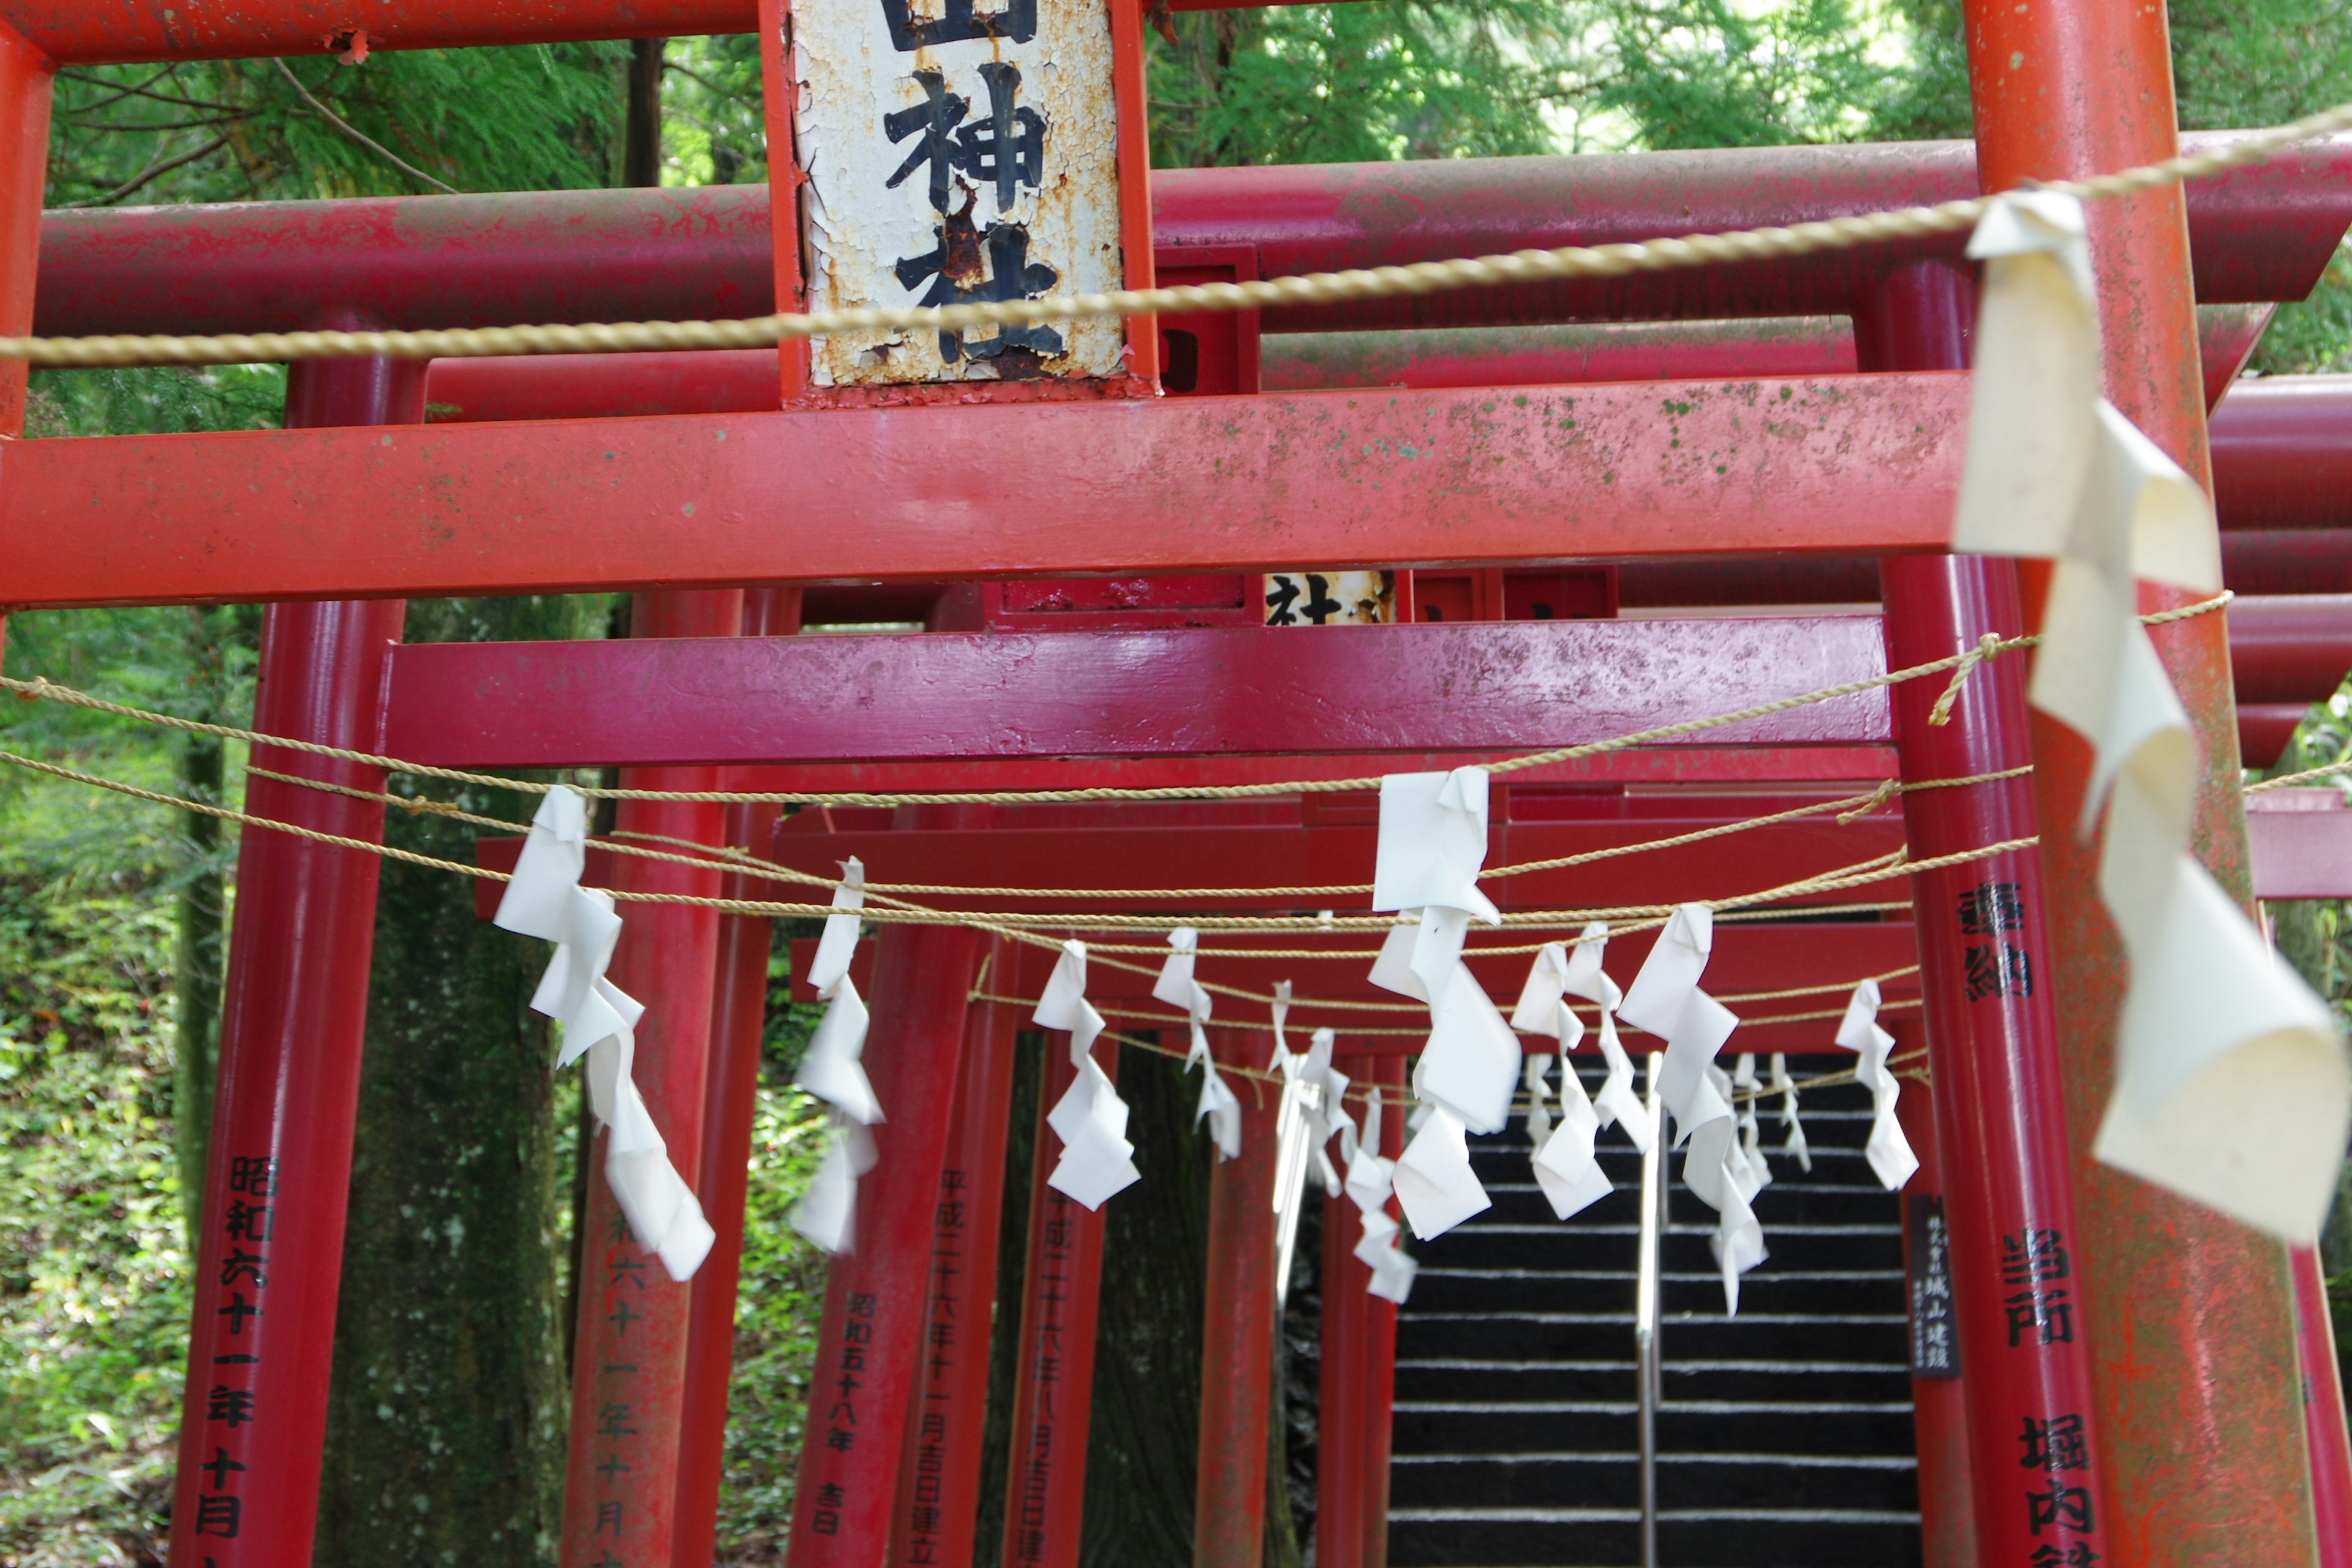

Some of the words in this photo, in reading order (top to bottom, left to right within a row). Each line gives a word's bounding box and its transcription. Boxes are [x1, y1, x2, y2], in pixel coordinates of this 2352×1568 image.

[1957, 882, 2034, 1002] 奉納
[2003, 1227, 2074, 1348] 当所
[196, 1155, 280, 1568] 昭和六十一年十月
[592, 1210, 647, 1568] 六十一年十月
[824, 1292, 876, 1454] 昭和五十八年
[908, 1169, 967, 1566] 平成二十六年十一月吉日建立
[1017, 1186, 1073, 1568] 平成二十六年八月吉日建
